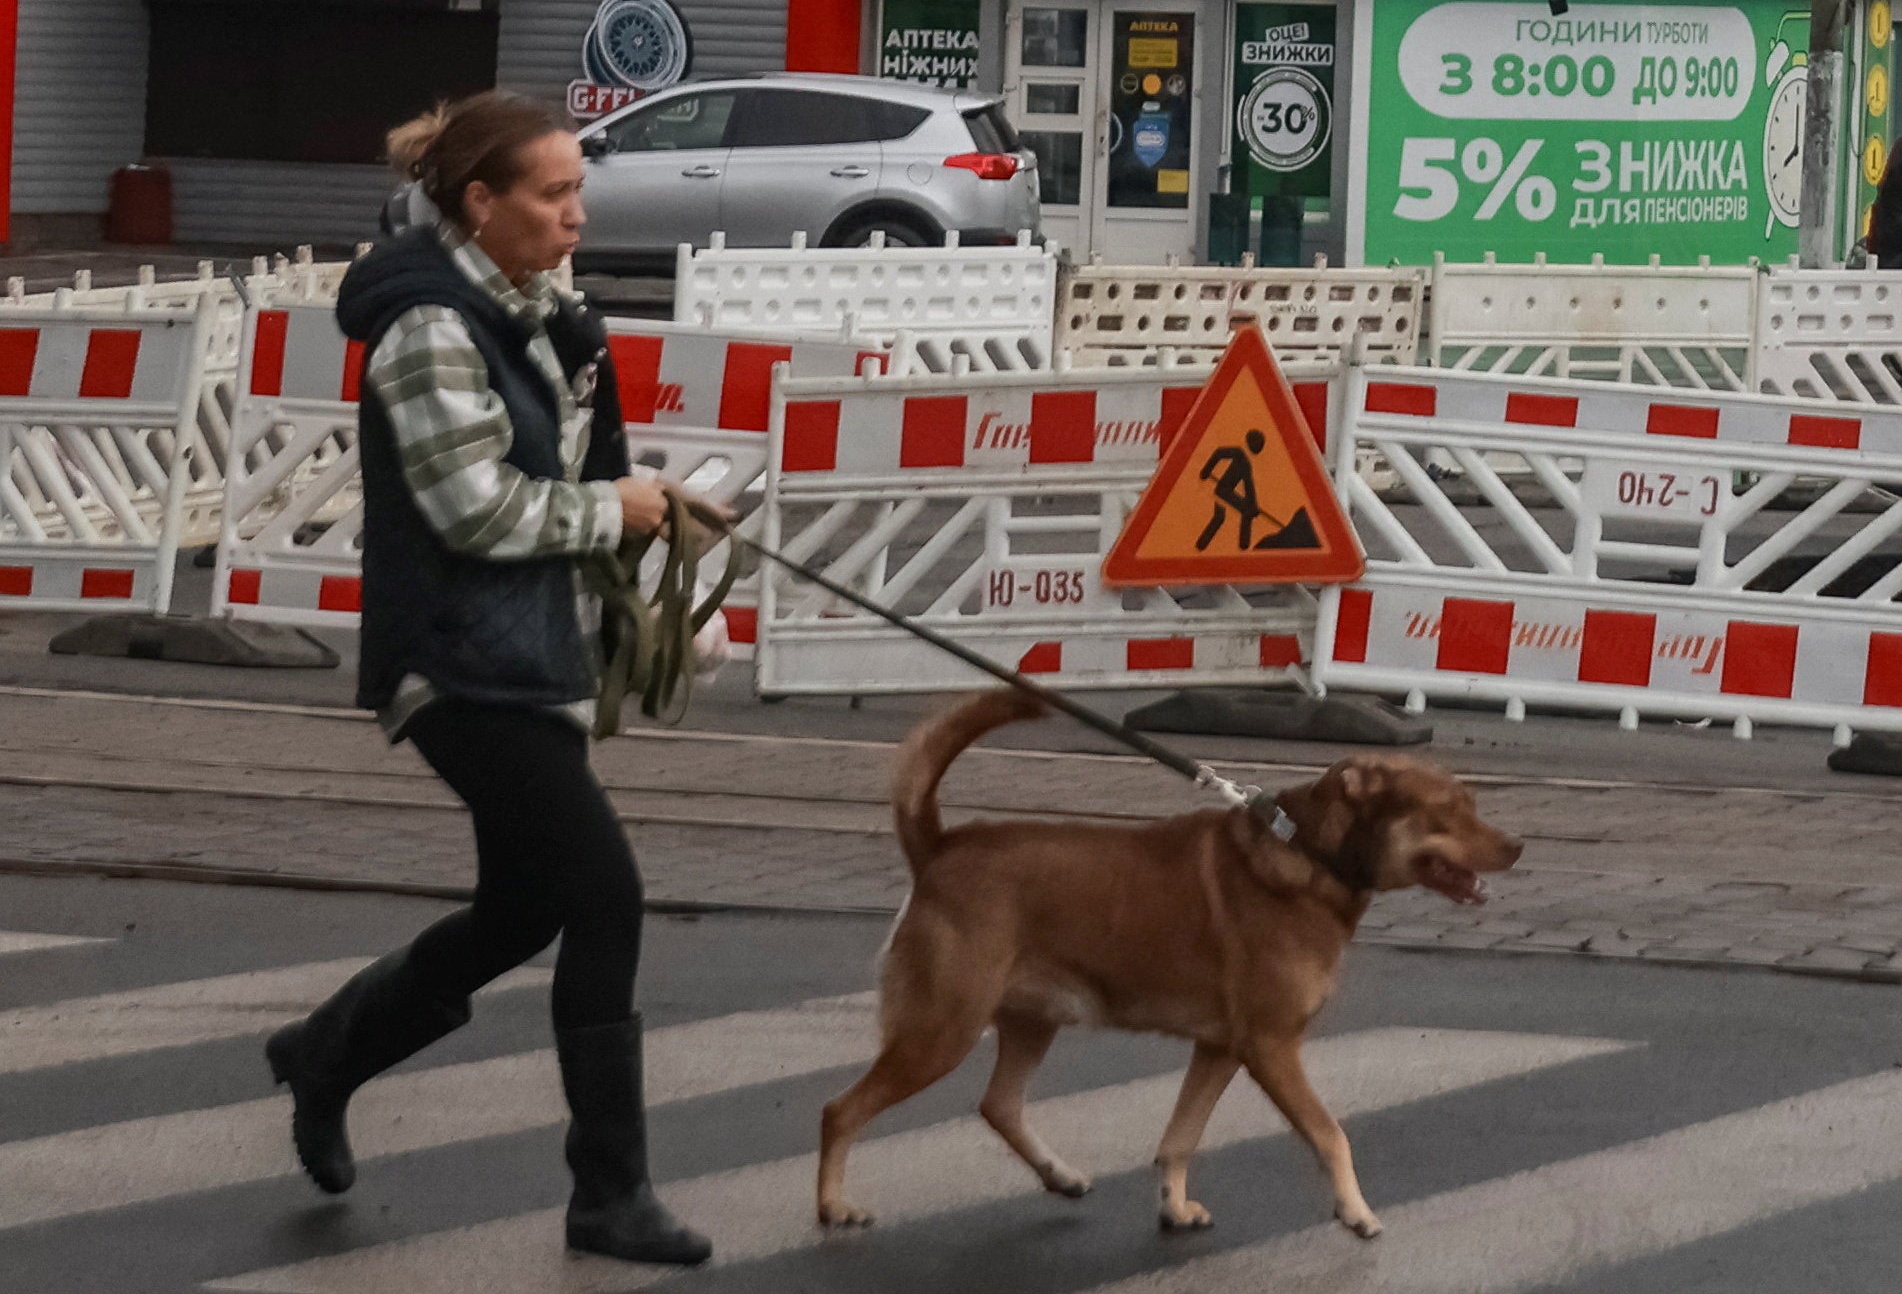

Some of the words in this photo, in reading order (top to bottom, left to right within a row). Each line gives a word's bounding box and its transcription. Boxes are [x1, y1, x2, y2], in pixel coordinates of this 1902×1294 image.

[885, 29, 979, 48] АПТЕКА
[1516, 19, 1641, 45] ГОДИНИ
[1648, 21, 1709, 45] ТУРБОТИ
[1246, 44, 1330, 62] ЗНИЖКИ
[1492, 54, 1616, 97] 8:00
[1632, 56, 1677, 105] ДО
[1684, 56, 1738, 98] 9:00
[1393, 137, 1557, 222] 5%
[1571, 140, 1748, 192] ЗНИЖКА
[1644, 196, 1748, 223] ПЕНСІОНЕРІВ
[989, 570, 1085, 607] Ю-035
